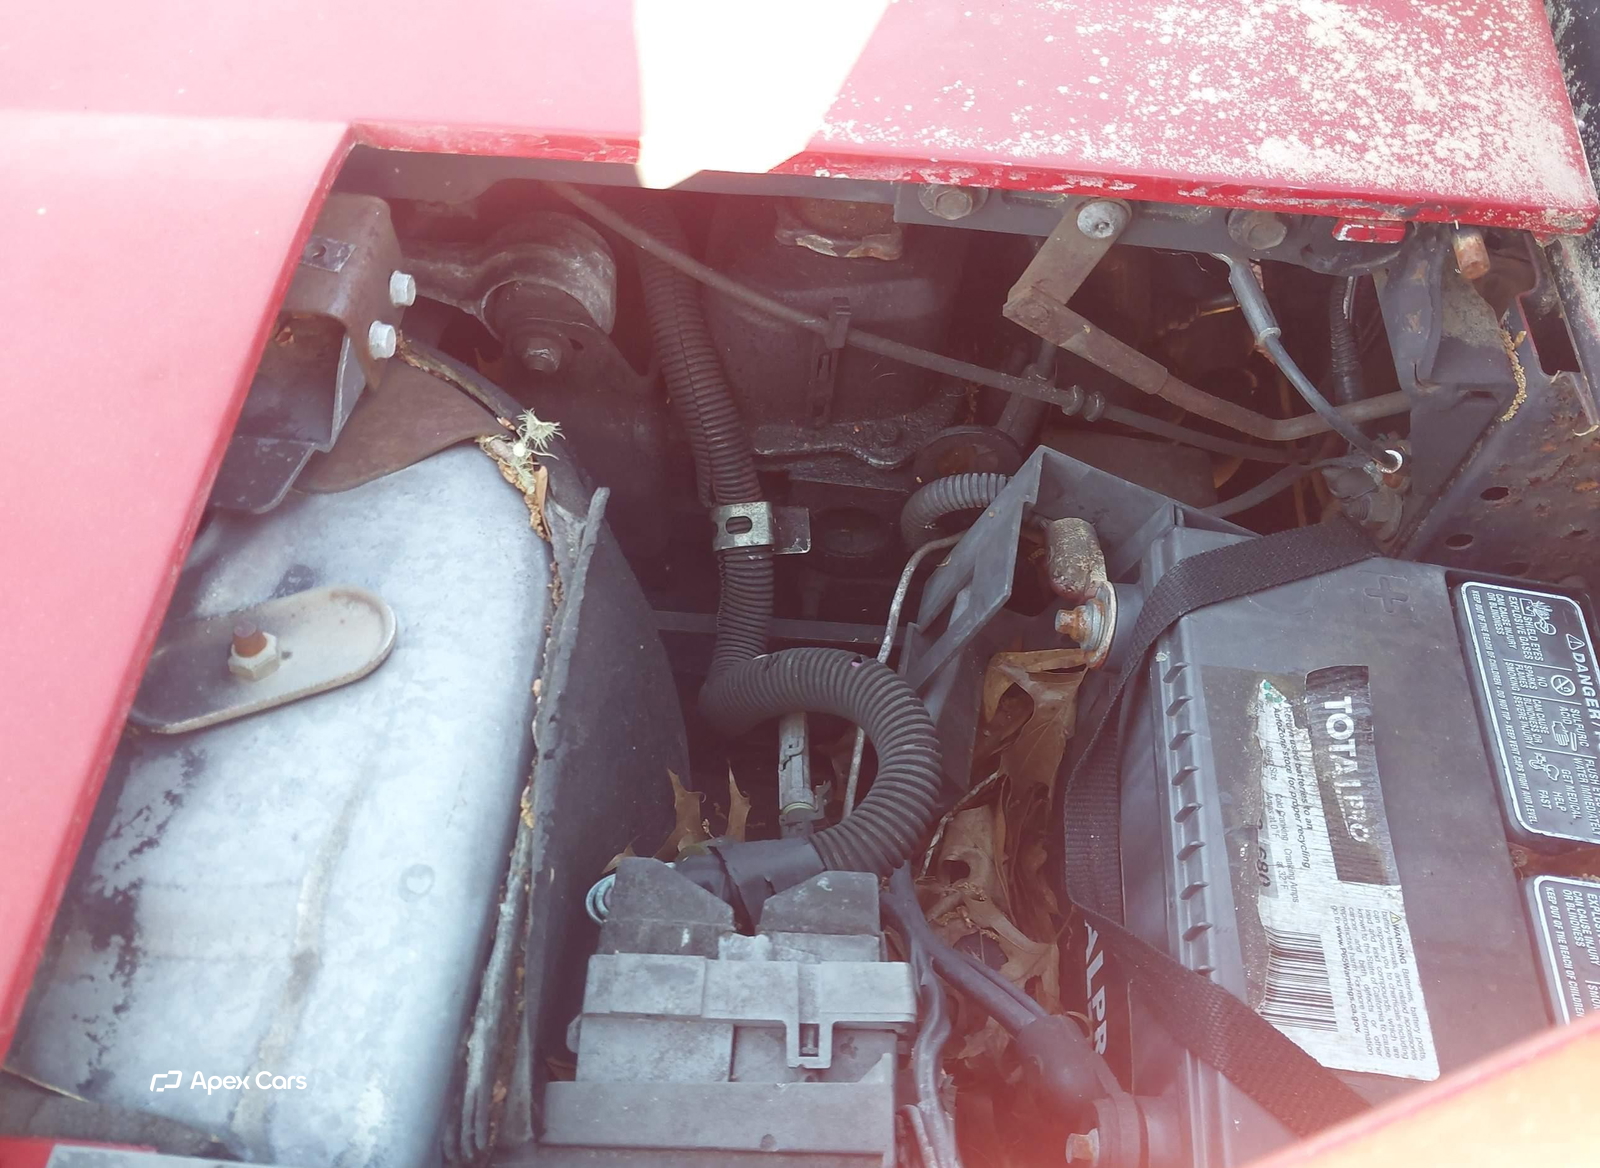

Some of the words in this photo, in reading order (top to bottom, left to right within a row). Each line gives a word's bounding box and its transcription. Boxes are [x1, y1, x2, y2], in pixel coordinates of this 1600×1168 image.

[1471, 590, 1482, 604] KEEP
[1486, 592, 1496, 601] OR
[1495, 593, 1506, 606] CAN
[1474, 604, 1485, 615] OUT
[1477, 614, 1486, 622] OF
[1489, 602, 1505, 635] BLINDNESS
[1498, 607, 1511, 626] CAUSE
[1479, 622, 1489, 633] THE
[1508, 596, 1527, 635] EXPLOSIVE
[1519, 636, 1533, 660] GASES
[1523, 616, 1538, 641] SHIELD
[1482, 632, 1493, 651] REACH
[1504, 627, 1517, 649] INJURY
[1486, 650, 1496, 659] OF
[1530, 643, 1544, 661] EYES
[1489, 658, 1502, 686] CHILDREN
[1505, 662, 1520, 691] SMOKING
[1515, 664, 1529, 688] FLAMES
[1524, 665, 1538, 690] SPARKS
[1537, 676, 1548, 687] NO
[1496, 689, 1506, 698] DO
[1498, 699, 1509, 711] NOT
[1513, 696, 1528, 720] SEVERE
[1532, 699, 1543, 712] CAN
[1559, 705, 1573, 725] ACID
[1501, 711, 1511, 721] TIP
[1523, 697, 1540, 732] BLINDNESS
[1532, 733, 1543, 743] OR
[1536, 713, 1550, 734] CAUSE
[1505, 724, 1516, 740] KEEP
[1520, 721, 1535, 745] INJURY
[1570, 708, 1589, 747] SULFURIC
[1289, 739, 1302, 761] used
[1509, 740, 1520, 755] VENT
[1282, 751, 1292, 774] store
[1513, 755, 1525, 772] CAPS
[1573, 758, 1589, 783] WATER
[1584, 759, 1600, 785] FLUSH
[1287, 776, 1296, 790] for
[1294, 762, 1308, 803] batteries
[1517, 773, 1529, 790] TIGHT
[1561, 769, 1574, 784] GET
[1274, 793, 1284, 809] Cold
[1289, 791, 1302, 823] proper
[1522, 790, 1533, 804] AND
[1538, 789, 1552, 809] FAST
[1552, 791, 1567, 811] HELP
[1565, 785, 1582, 819] MEDICAL
[1268, 815, 1277, 823] at
[1301, 805, 1311, 816] to
[1276, 810, 1289, 841] Cranking
[1305, 818, 1313, 831] an
[1296, 824, 1311, 869] recycling
[1284, 848, 1296, 879] Cranking
[1289, 881, 1299, 903] Amps
[1545, 886, 1557, 905] KEEP
[1562, 889, 1574, 901] OR
[1572, 890, 1584, 907] CAN
[1549, 905, 1561, 919] OUT
[1576, 908, 1592, 935] CAUSE
[1553, 920, 1564, 930] OF
[1565, 902, 1585, 947] BLINDNESS
[1392, 924, 1407, 964] WARNING
[1555, 931, 1567, 944] THE
[1559, 944, 1573, 969] REACH
[1584, 936, 1600, 966] INJURY
[1565, 970, 1576, 980] OF
[1401, 968, 1414, 1003] Batteries,
[1410, 1006, 1421, 1034] battery
[1415, 1037, 1426, 1061] posts,
